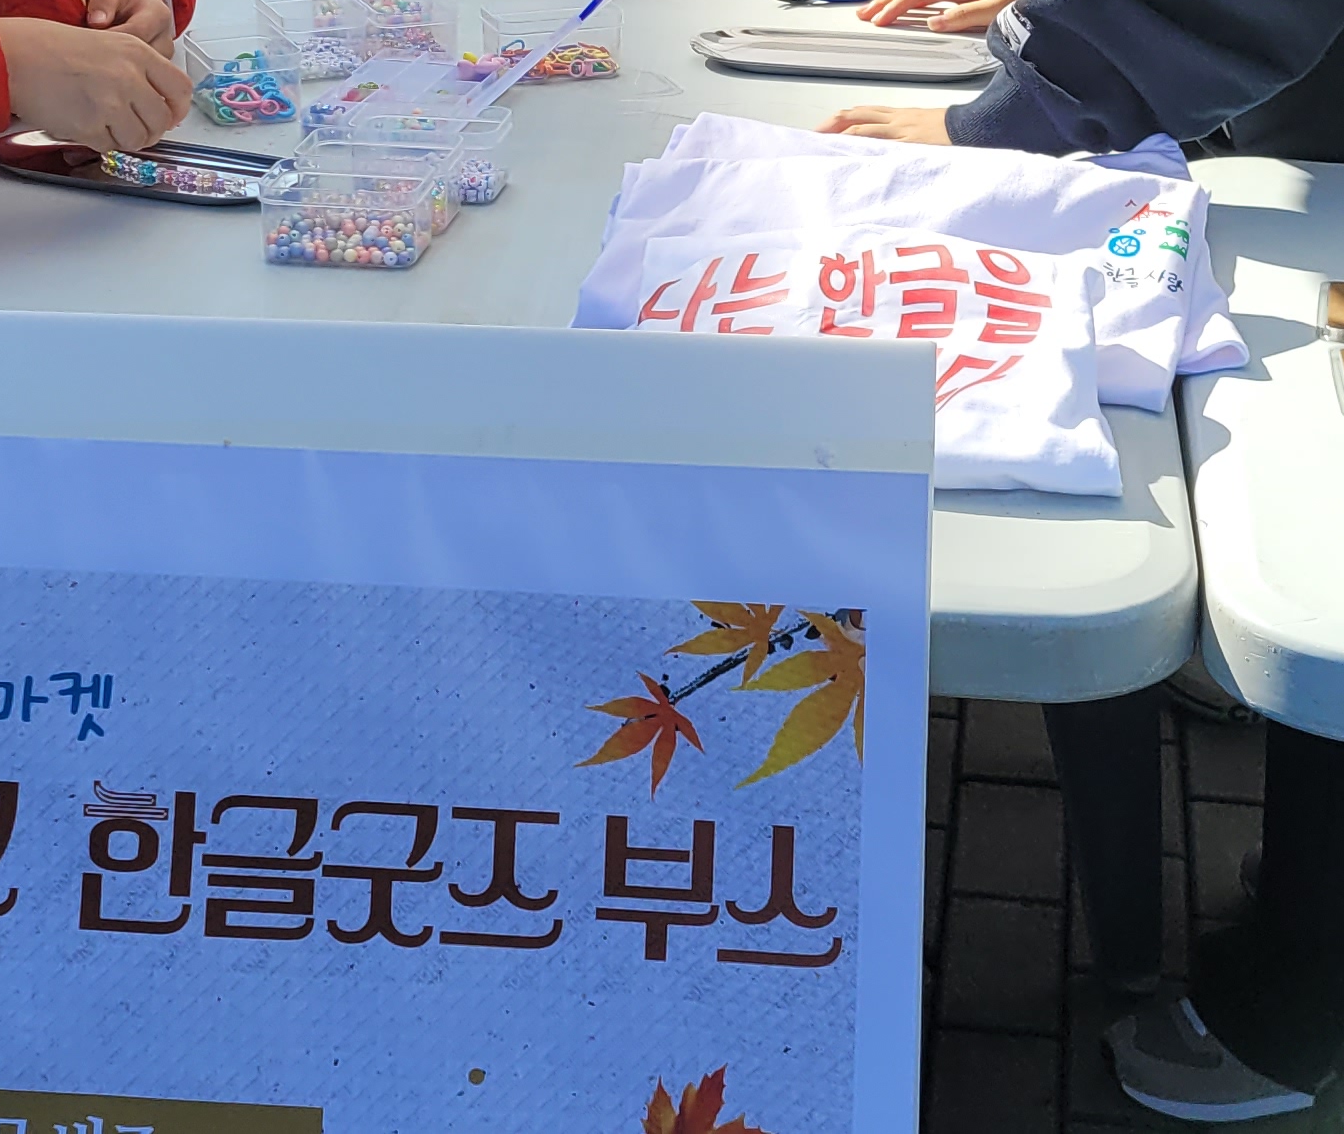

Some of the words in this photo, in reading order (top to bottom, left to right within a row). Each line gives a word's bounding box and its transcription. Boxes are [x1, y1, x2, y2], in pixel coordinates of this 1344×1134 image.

[637, 252, 791, 335] 나는
[817, 244, 1054, 345] 한글을
[1103, 261, 1140, 289] 한글
[1144, 269, 1185, 294] 사랑
[77, 779, 566, 951] 한글굿즈
[594, 814, 846, 970] 부스
